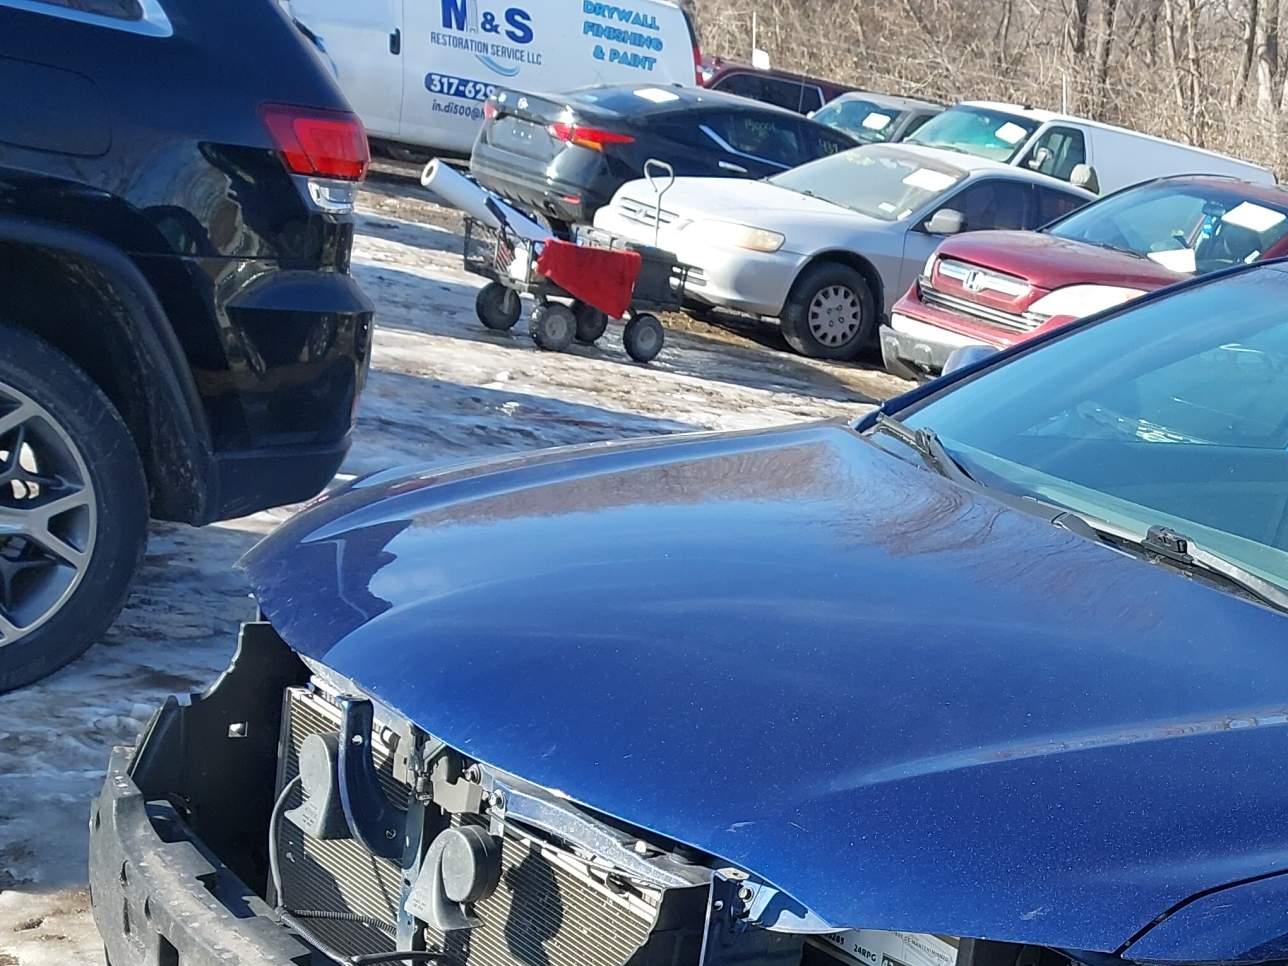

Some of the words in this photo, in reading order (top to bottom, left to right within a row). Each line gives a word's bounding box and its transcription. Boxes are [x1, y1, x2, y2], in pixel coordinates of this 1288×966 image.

[481, 11, 499, 34] &
[504, 8, 533, 44] S
[583, 0, 660, 31] DRYWALL
[430, 32, 489, 55] RESTORATION
[490, 44, 525, 62] SERVICE
[526, 52, 542, 65] LLC
[583, 21, 663, 52] FINISHING
[593, 45, 605, 60] &
[609, 48, 656, 71] PAINT
[853, 943, 877, 962] 24RPG
